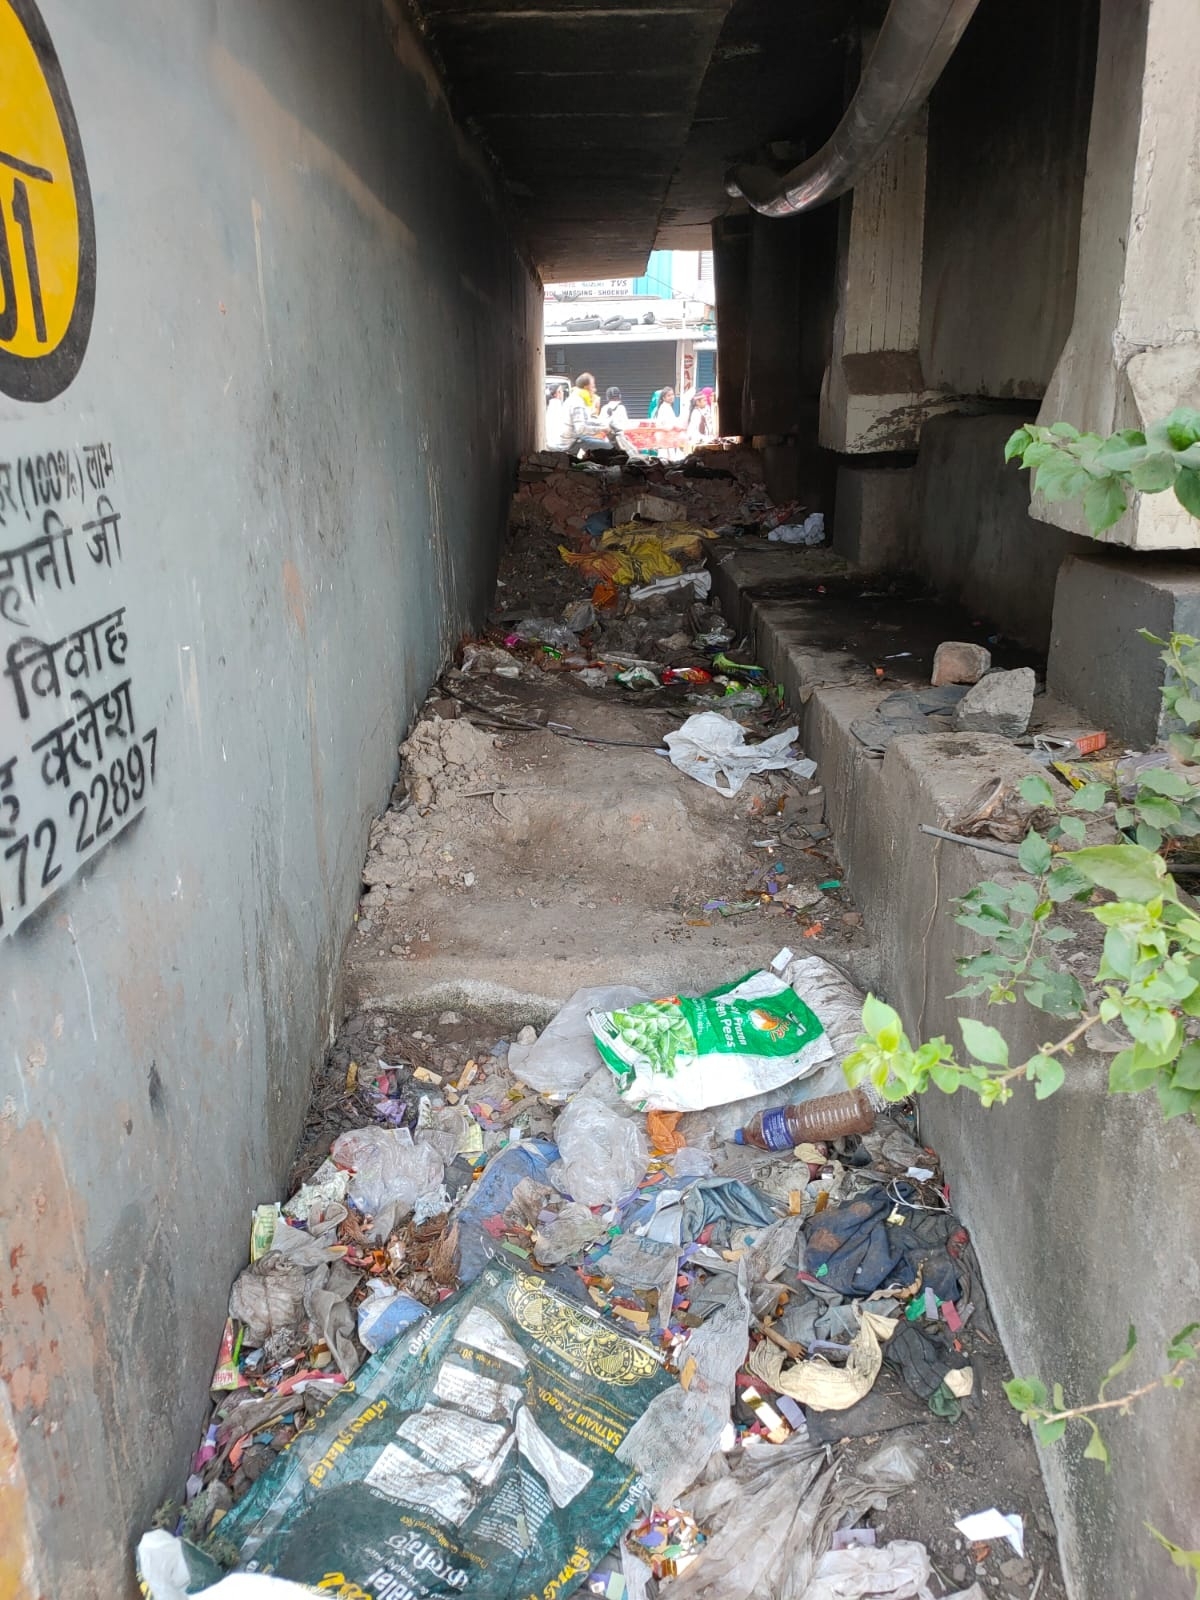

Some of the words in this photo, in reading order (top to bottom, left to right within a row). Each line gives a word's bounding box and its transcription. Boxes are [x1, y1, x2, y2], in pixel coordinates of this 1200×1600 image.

[82, 494, 122, 568] जी
[4, 607, 128, 720] विवाह
[31, 678, 136, 788] क्लेश
[69, 727, 157, 853] 22897
[721, 1018, 736, 1048] Peas
[576, 1413, 622, 1446] SATNAM
